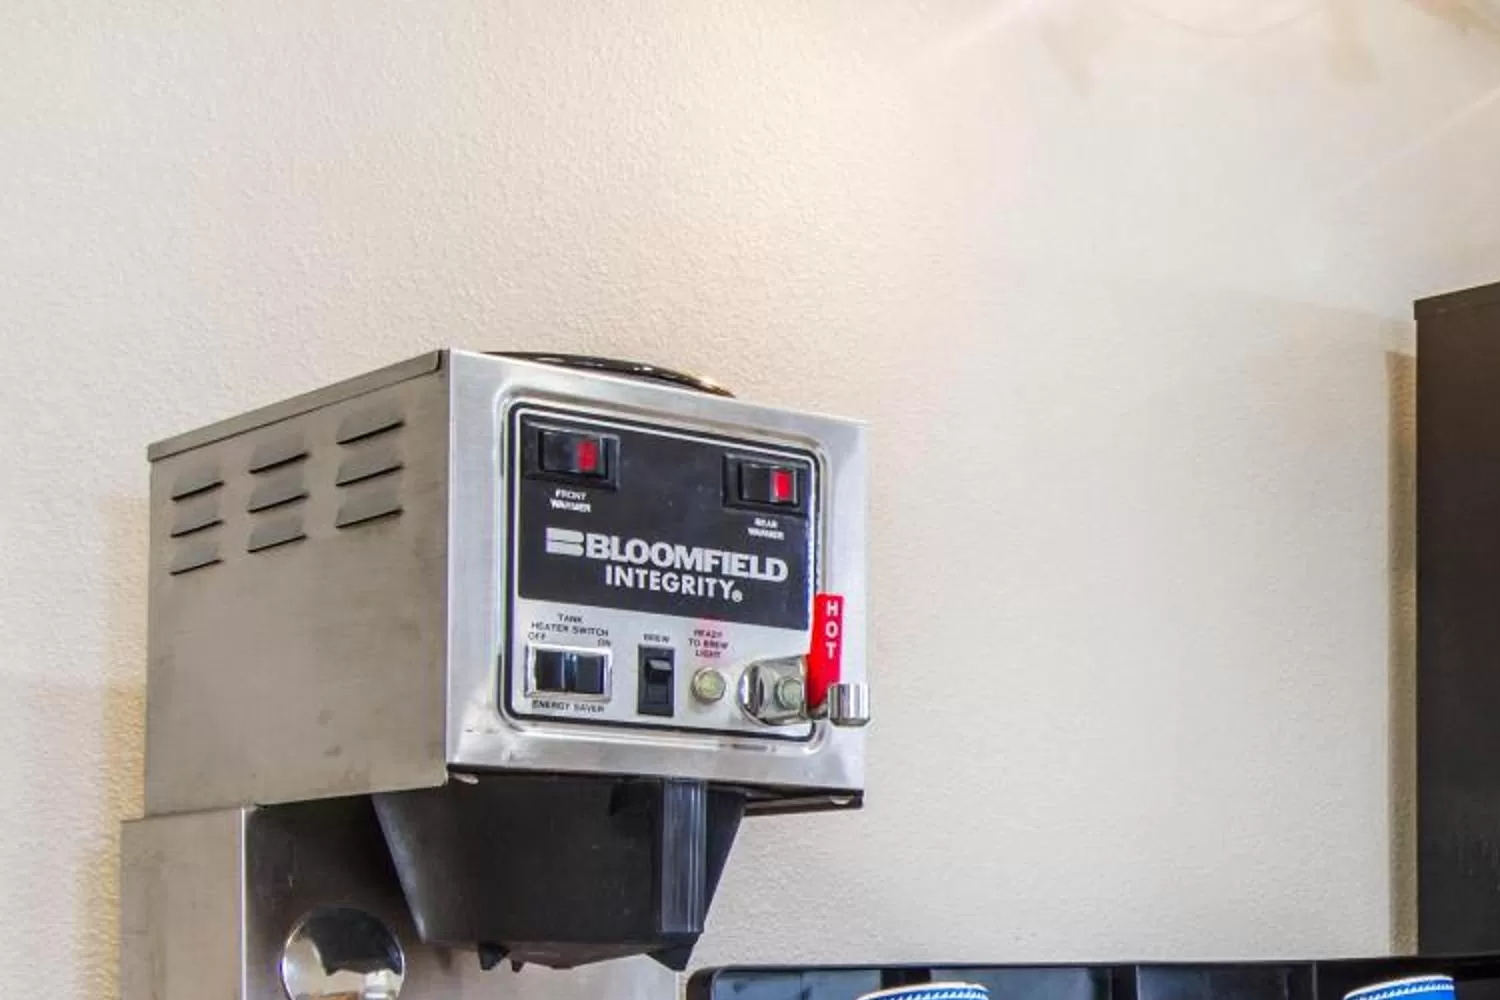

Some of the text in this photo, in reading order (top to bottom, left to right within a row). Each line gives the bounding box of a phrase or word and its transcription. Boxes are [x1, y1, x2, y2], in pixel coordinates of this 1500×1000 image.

[555, 488, 587, 500] FRONT
[550, 498, 592, 513] WARMER
[754, 517, 778, 528] REAR
[747, 527, 785, 541] WARMER
[585, 532, 789, 582] BLOOMFIELD
[557, 613, 583, 624] TANK
[531, 621, 609, 637] HEATER SWITCH
[825, 600, 839, 659] HOT
[527, 632, 546, 641] OFF
[643, 633, 670, 643] BREW
[597, 638, 611, 648] ON
[688, 638, 729, 650] TO BREW
[532, 700, 605, 713] ENERGY SAVER
